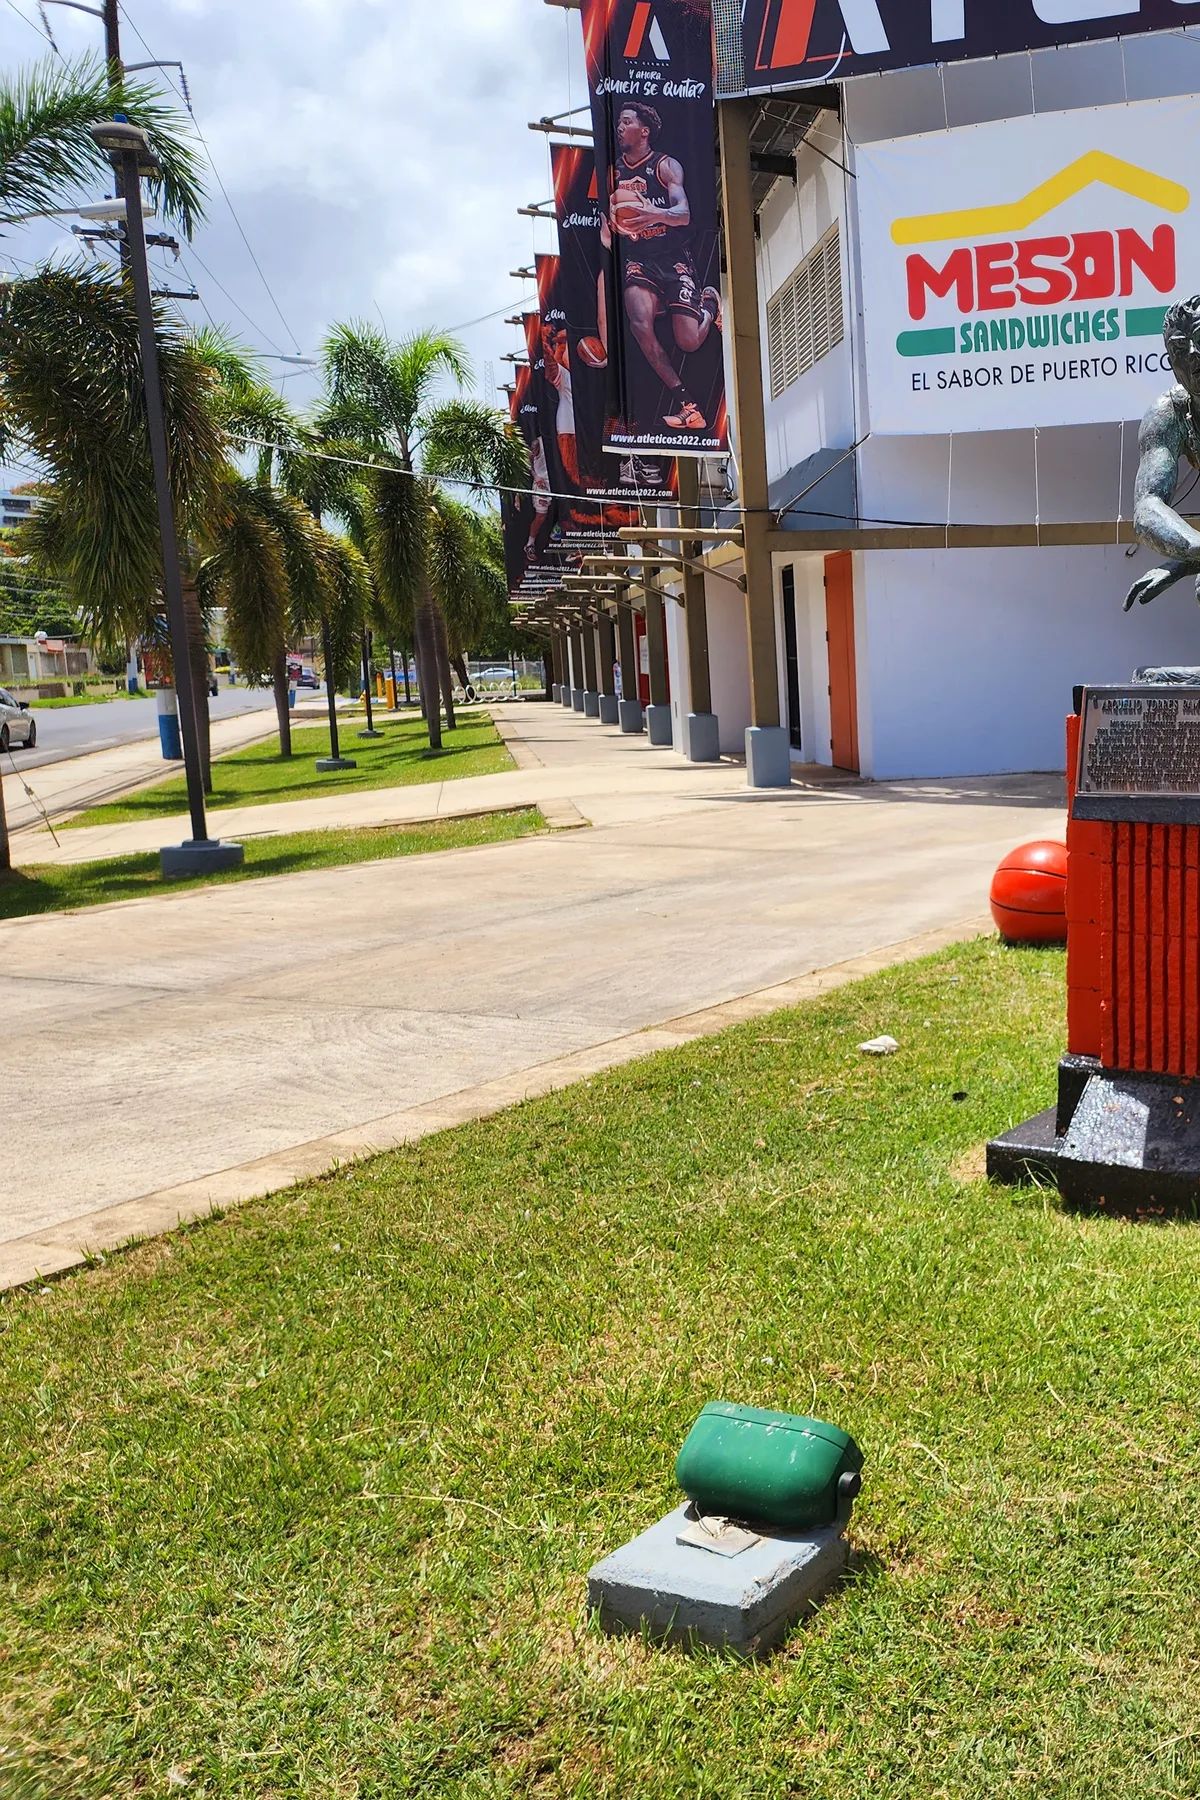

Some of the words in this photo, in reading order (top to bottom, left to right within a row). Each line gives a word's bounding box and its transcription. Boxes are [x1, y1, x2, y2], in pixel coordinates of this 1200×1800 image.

[628, 69, 635, 80] Y
[905, 223, 1177, 321] MESON
[960, 308, 1120, 353] SANDWICHES
[911, 373, 931, 391] EL
[937, 366, 1003, 390] SABOR
[1011, 363, 1035, 385] DE
[1043, 356, 1118, 382] PUERTO
[610, 433, 720, 446] www.atleticos2022.com
[586, 487, 673, 498] www.atleticos2022.com
